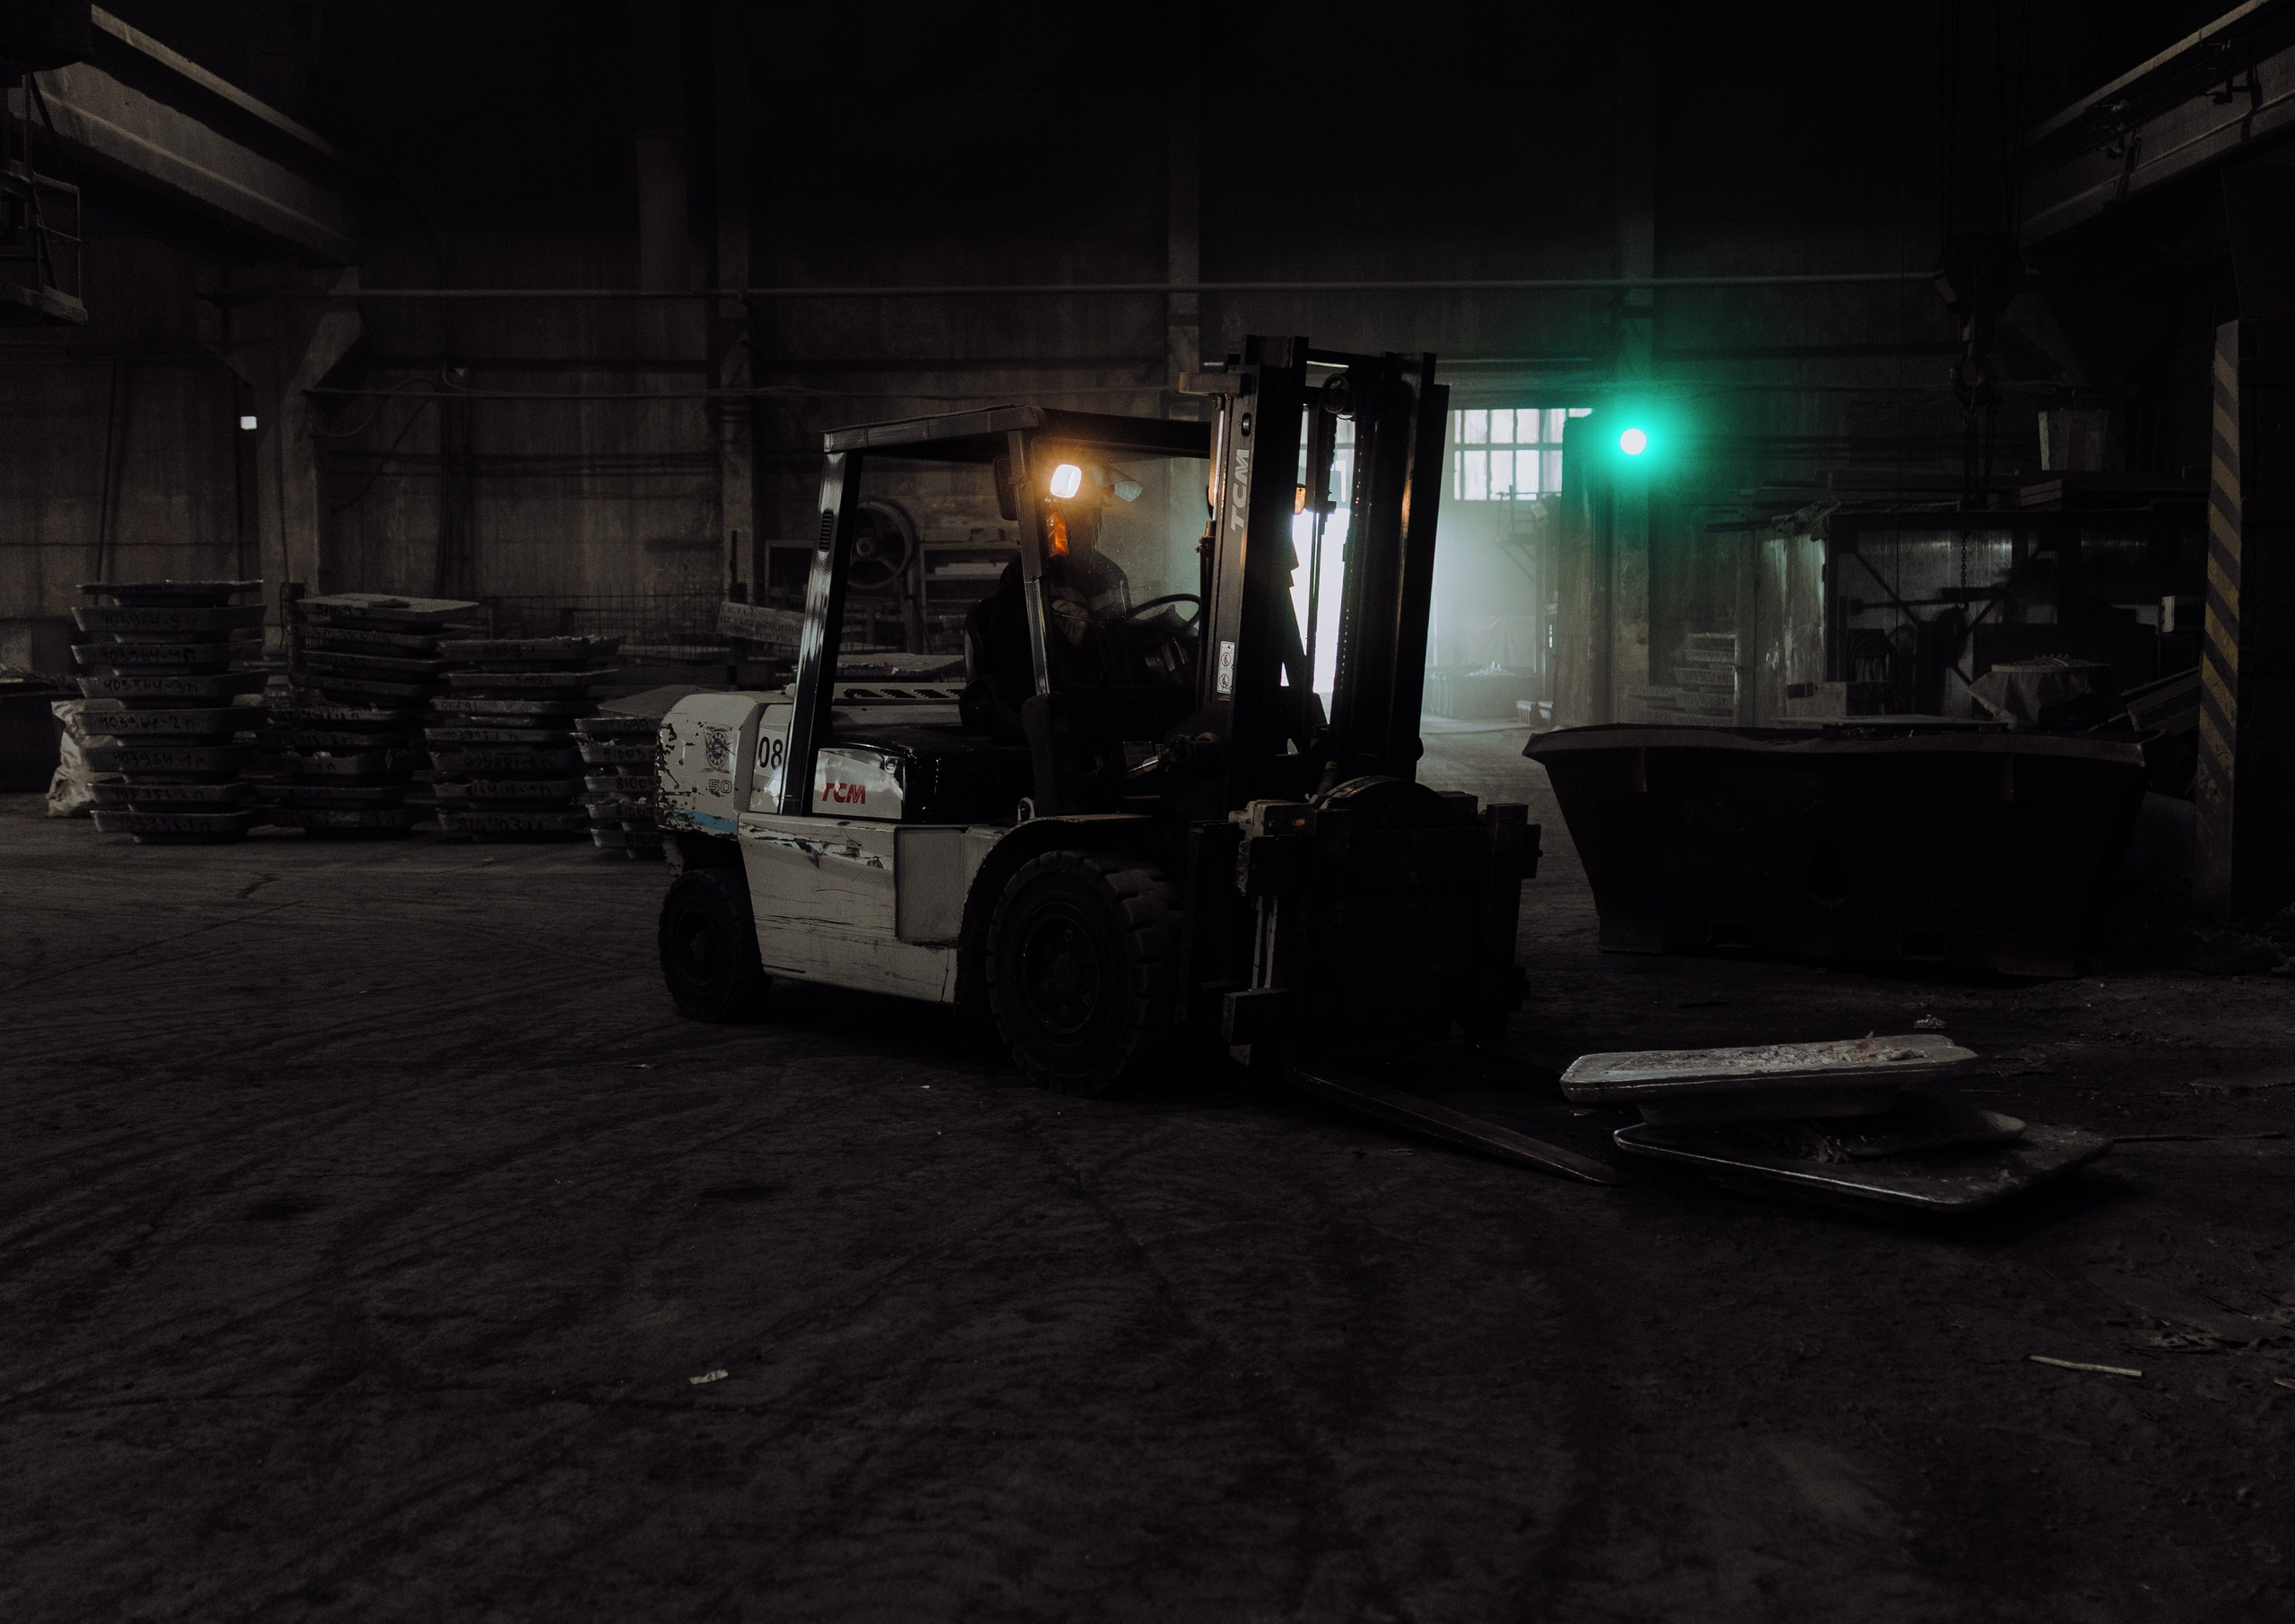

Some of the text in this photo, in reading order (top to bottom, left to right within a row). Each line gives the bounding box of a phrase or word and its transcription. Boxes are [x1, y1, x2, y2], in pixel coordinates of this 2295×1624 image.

[1231, 449, 1250, 531] TCM
[758, 737, 784, 771] 08
[708, 779, 732, 794] 50
[822, 782, 866, 804] TCM
